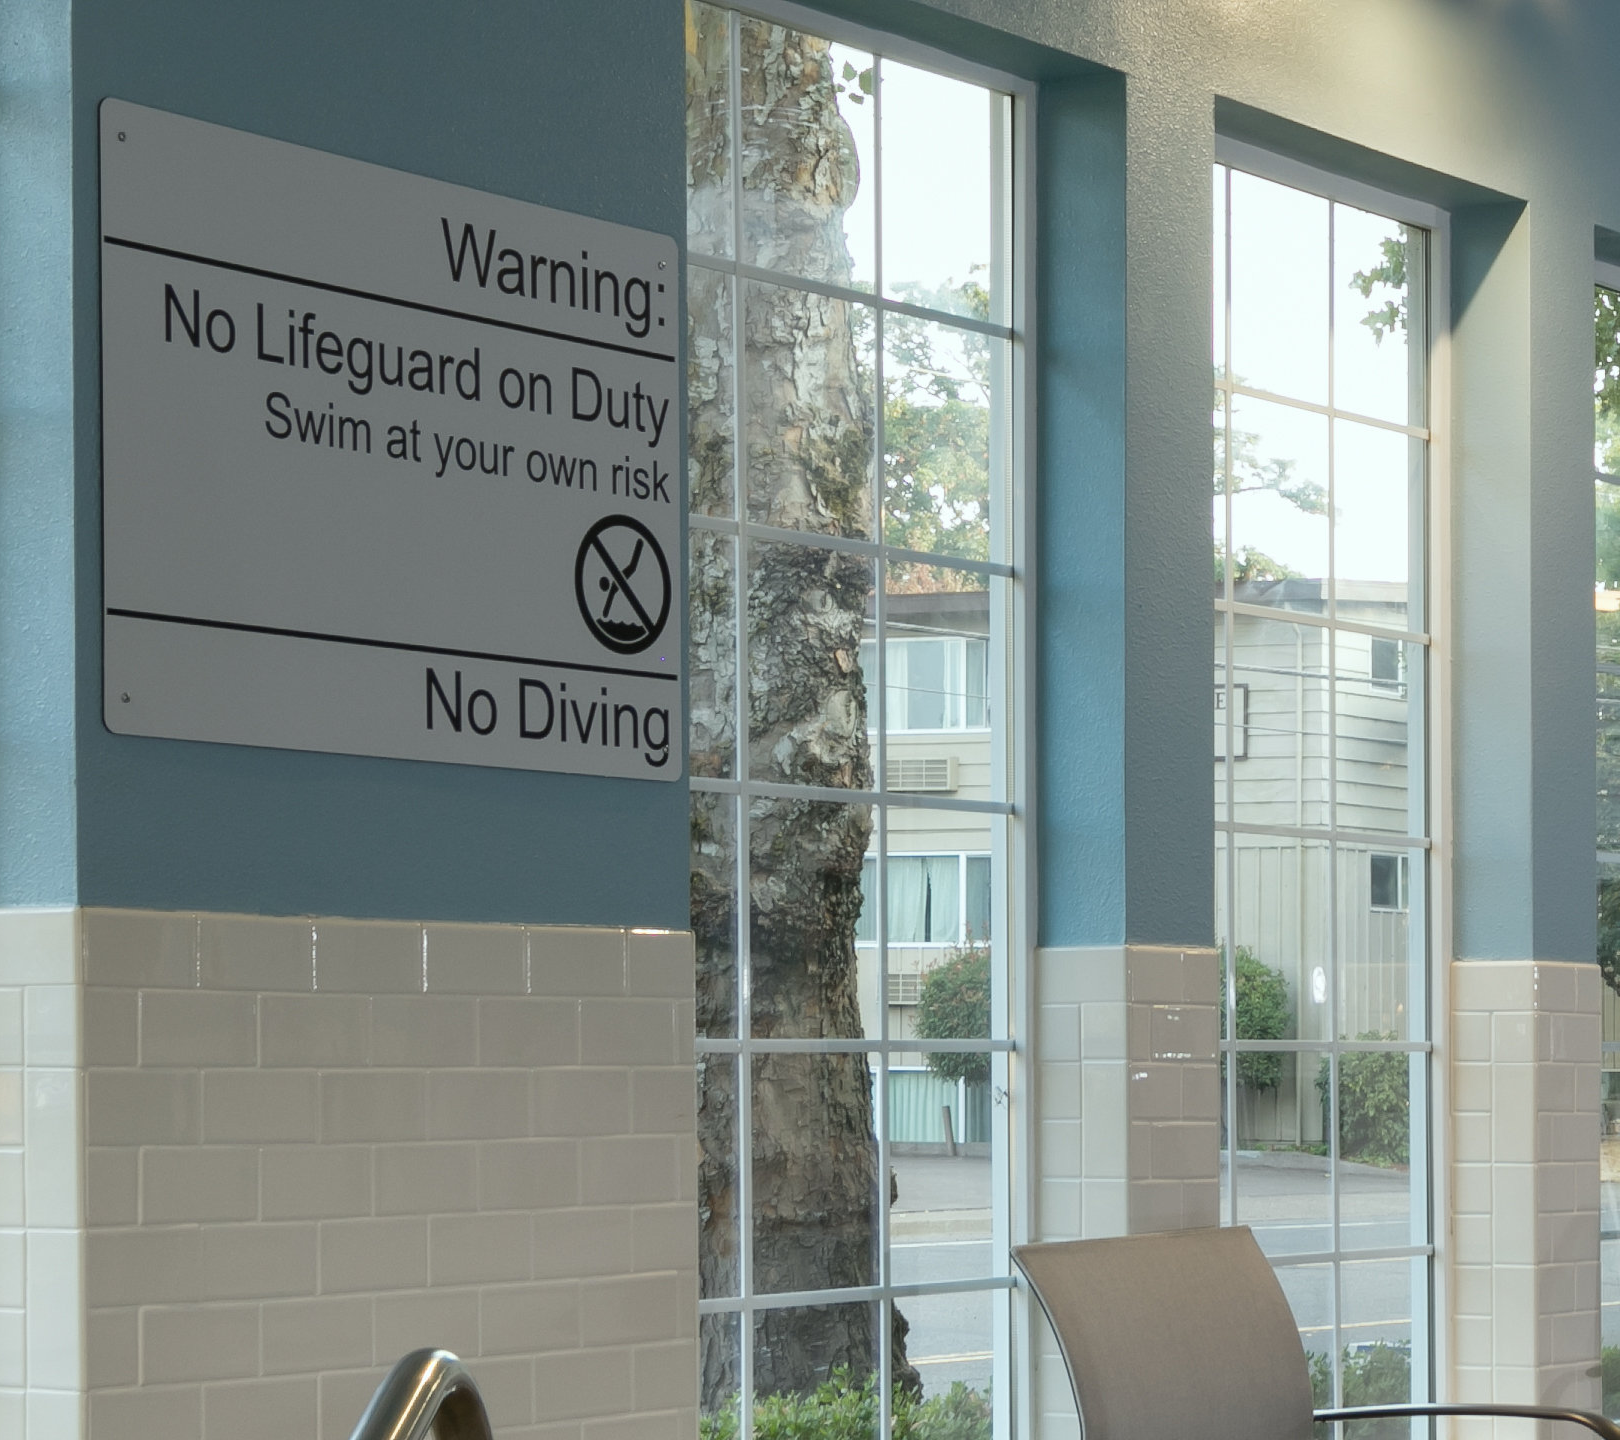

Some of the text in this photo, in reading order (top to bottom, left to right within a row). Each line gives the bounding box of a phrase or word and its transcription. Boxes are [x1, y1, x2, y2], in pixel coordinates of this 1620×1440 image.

[441, 217, 668, 339] Warning:
[164, 283, 671, 448] No Lifeguard on Duty
[265, 392, 671, 504] Swim at your own risk
[426, 667, 671, 768] No Diving
